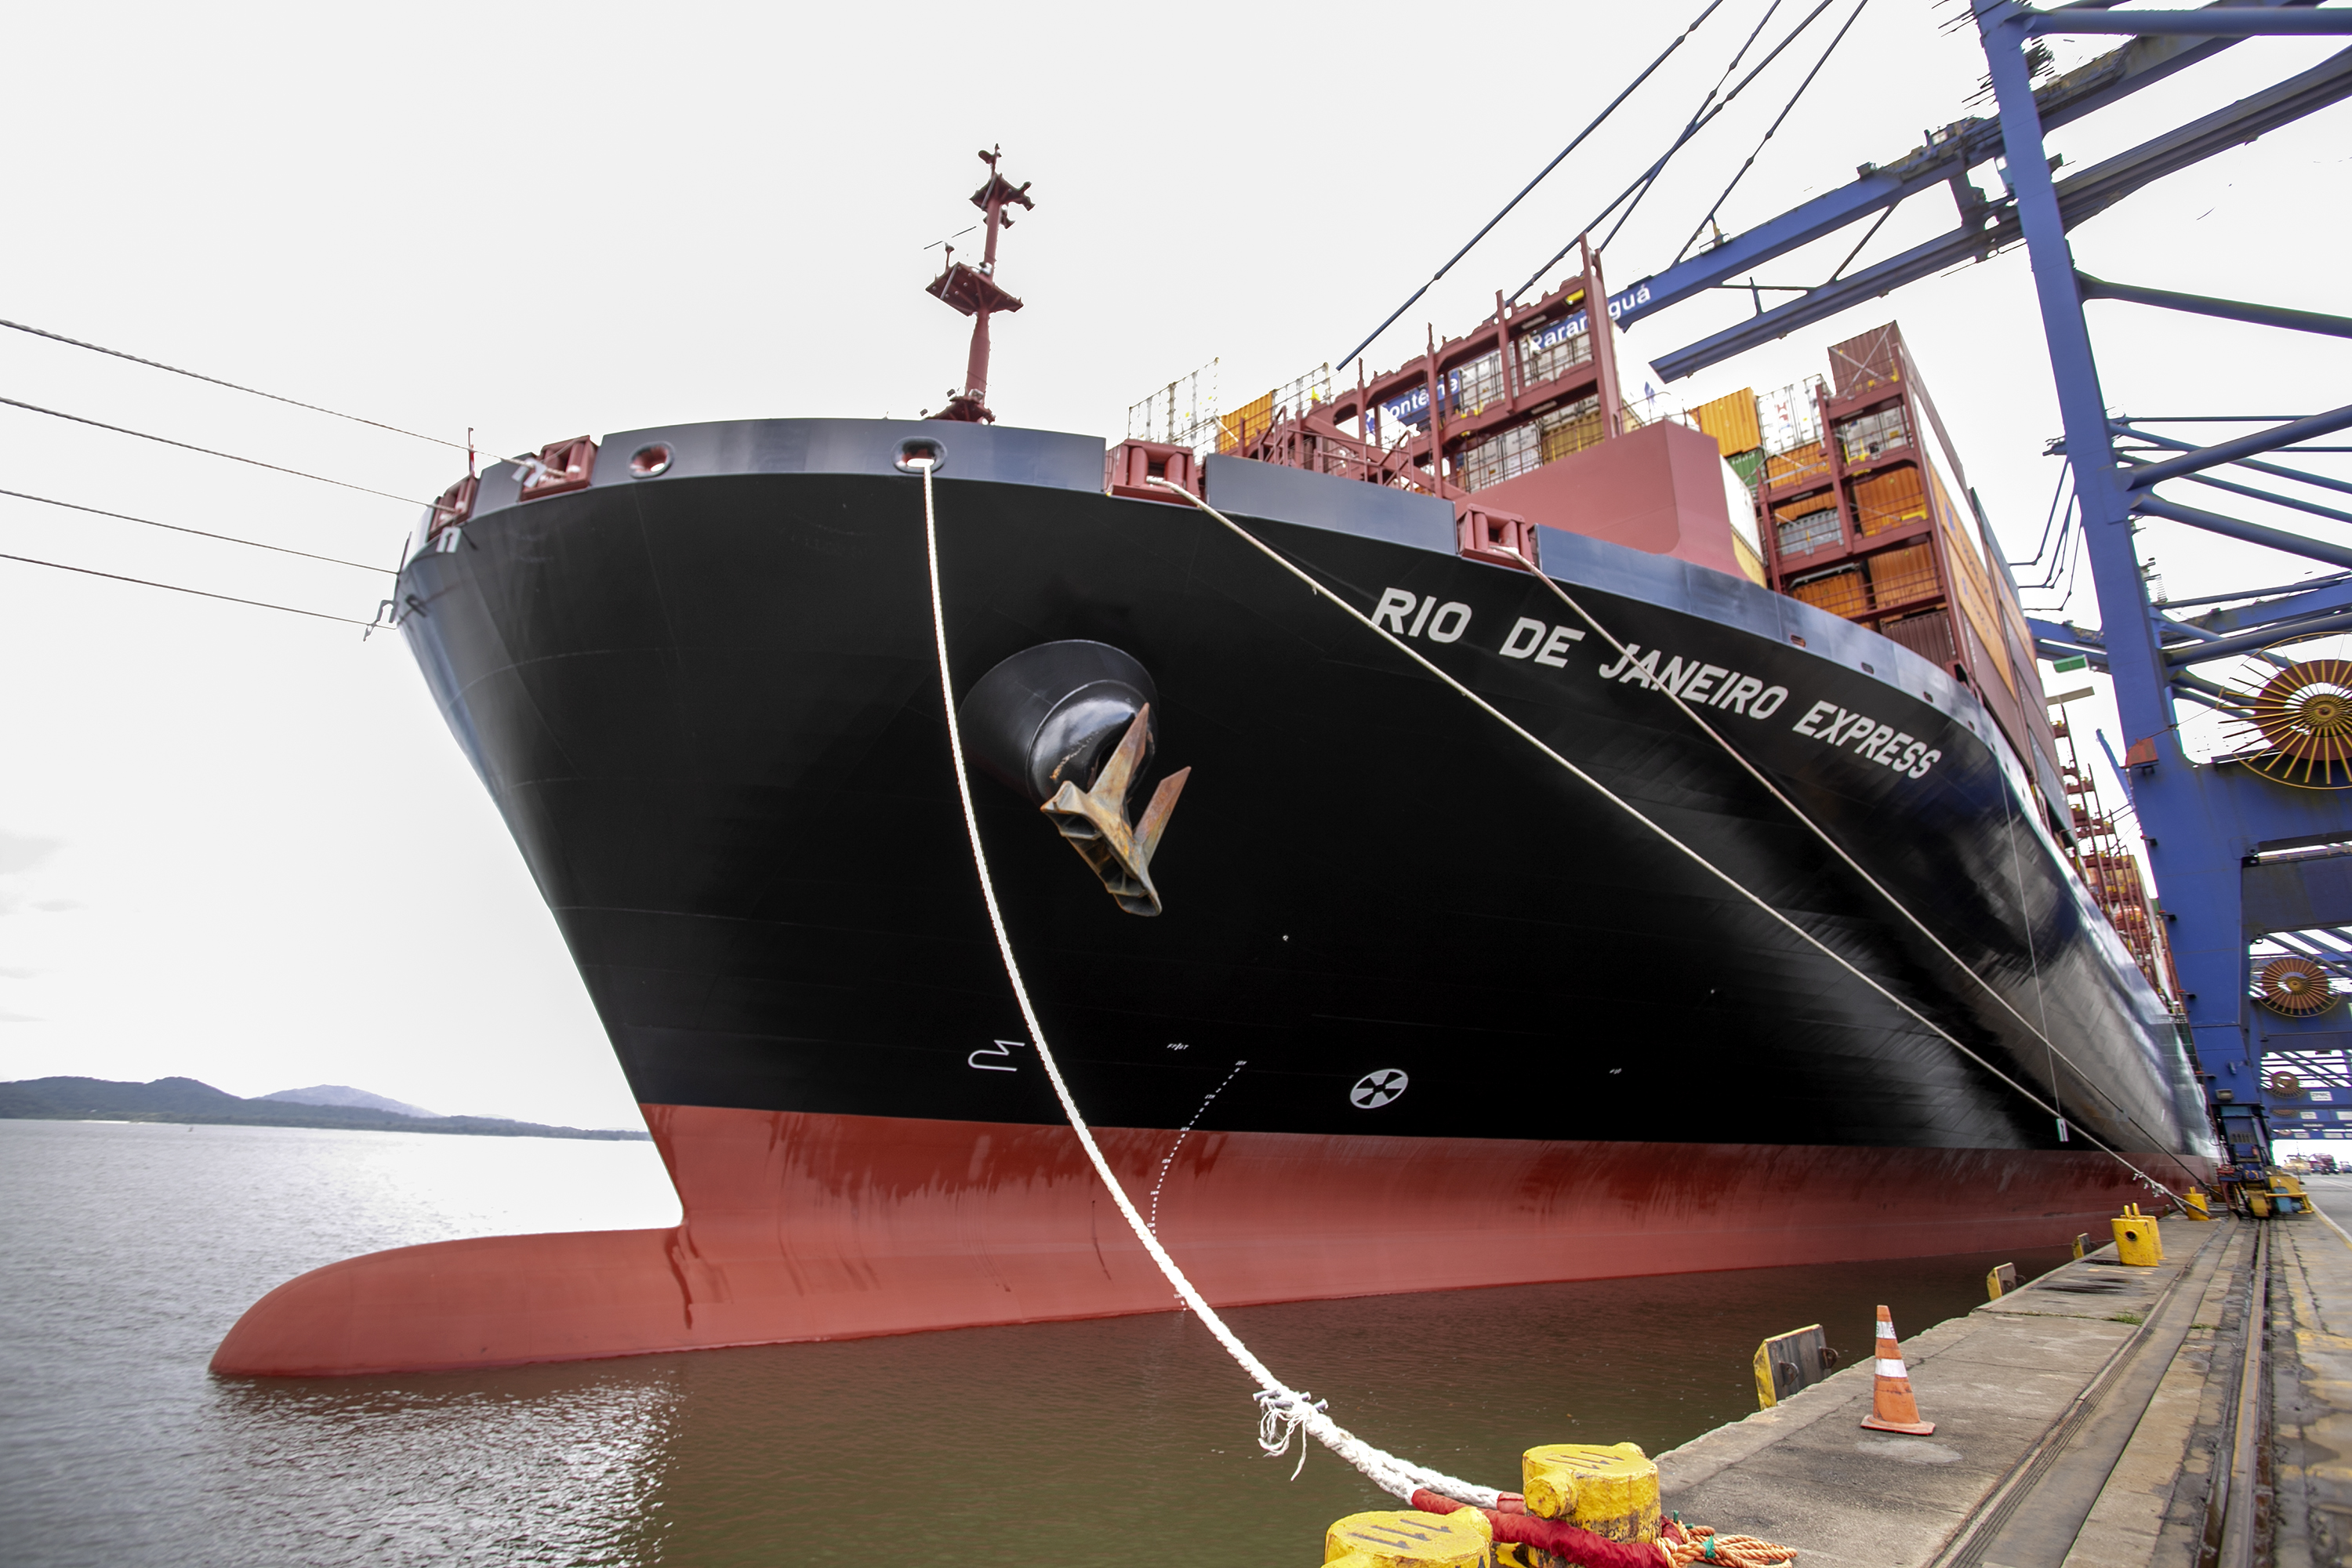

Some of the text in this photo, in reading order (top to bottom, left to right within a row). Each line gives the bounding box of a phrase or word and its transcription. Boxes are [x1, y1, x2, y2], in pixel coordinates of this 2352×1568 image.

[1370, 587, 1942, 779] RIO DE JANEIRO EXPRESS
